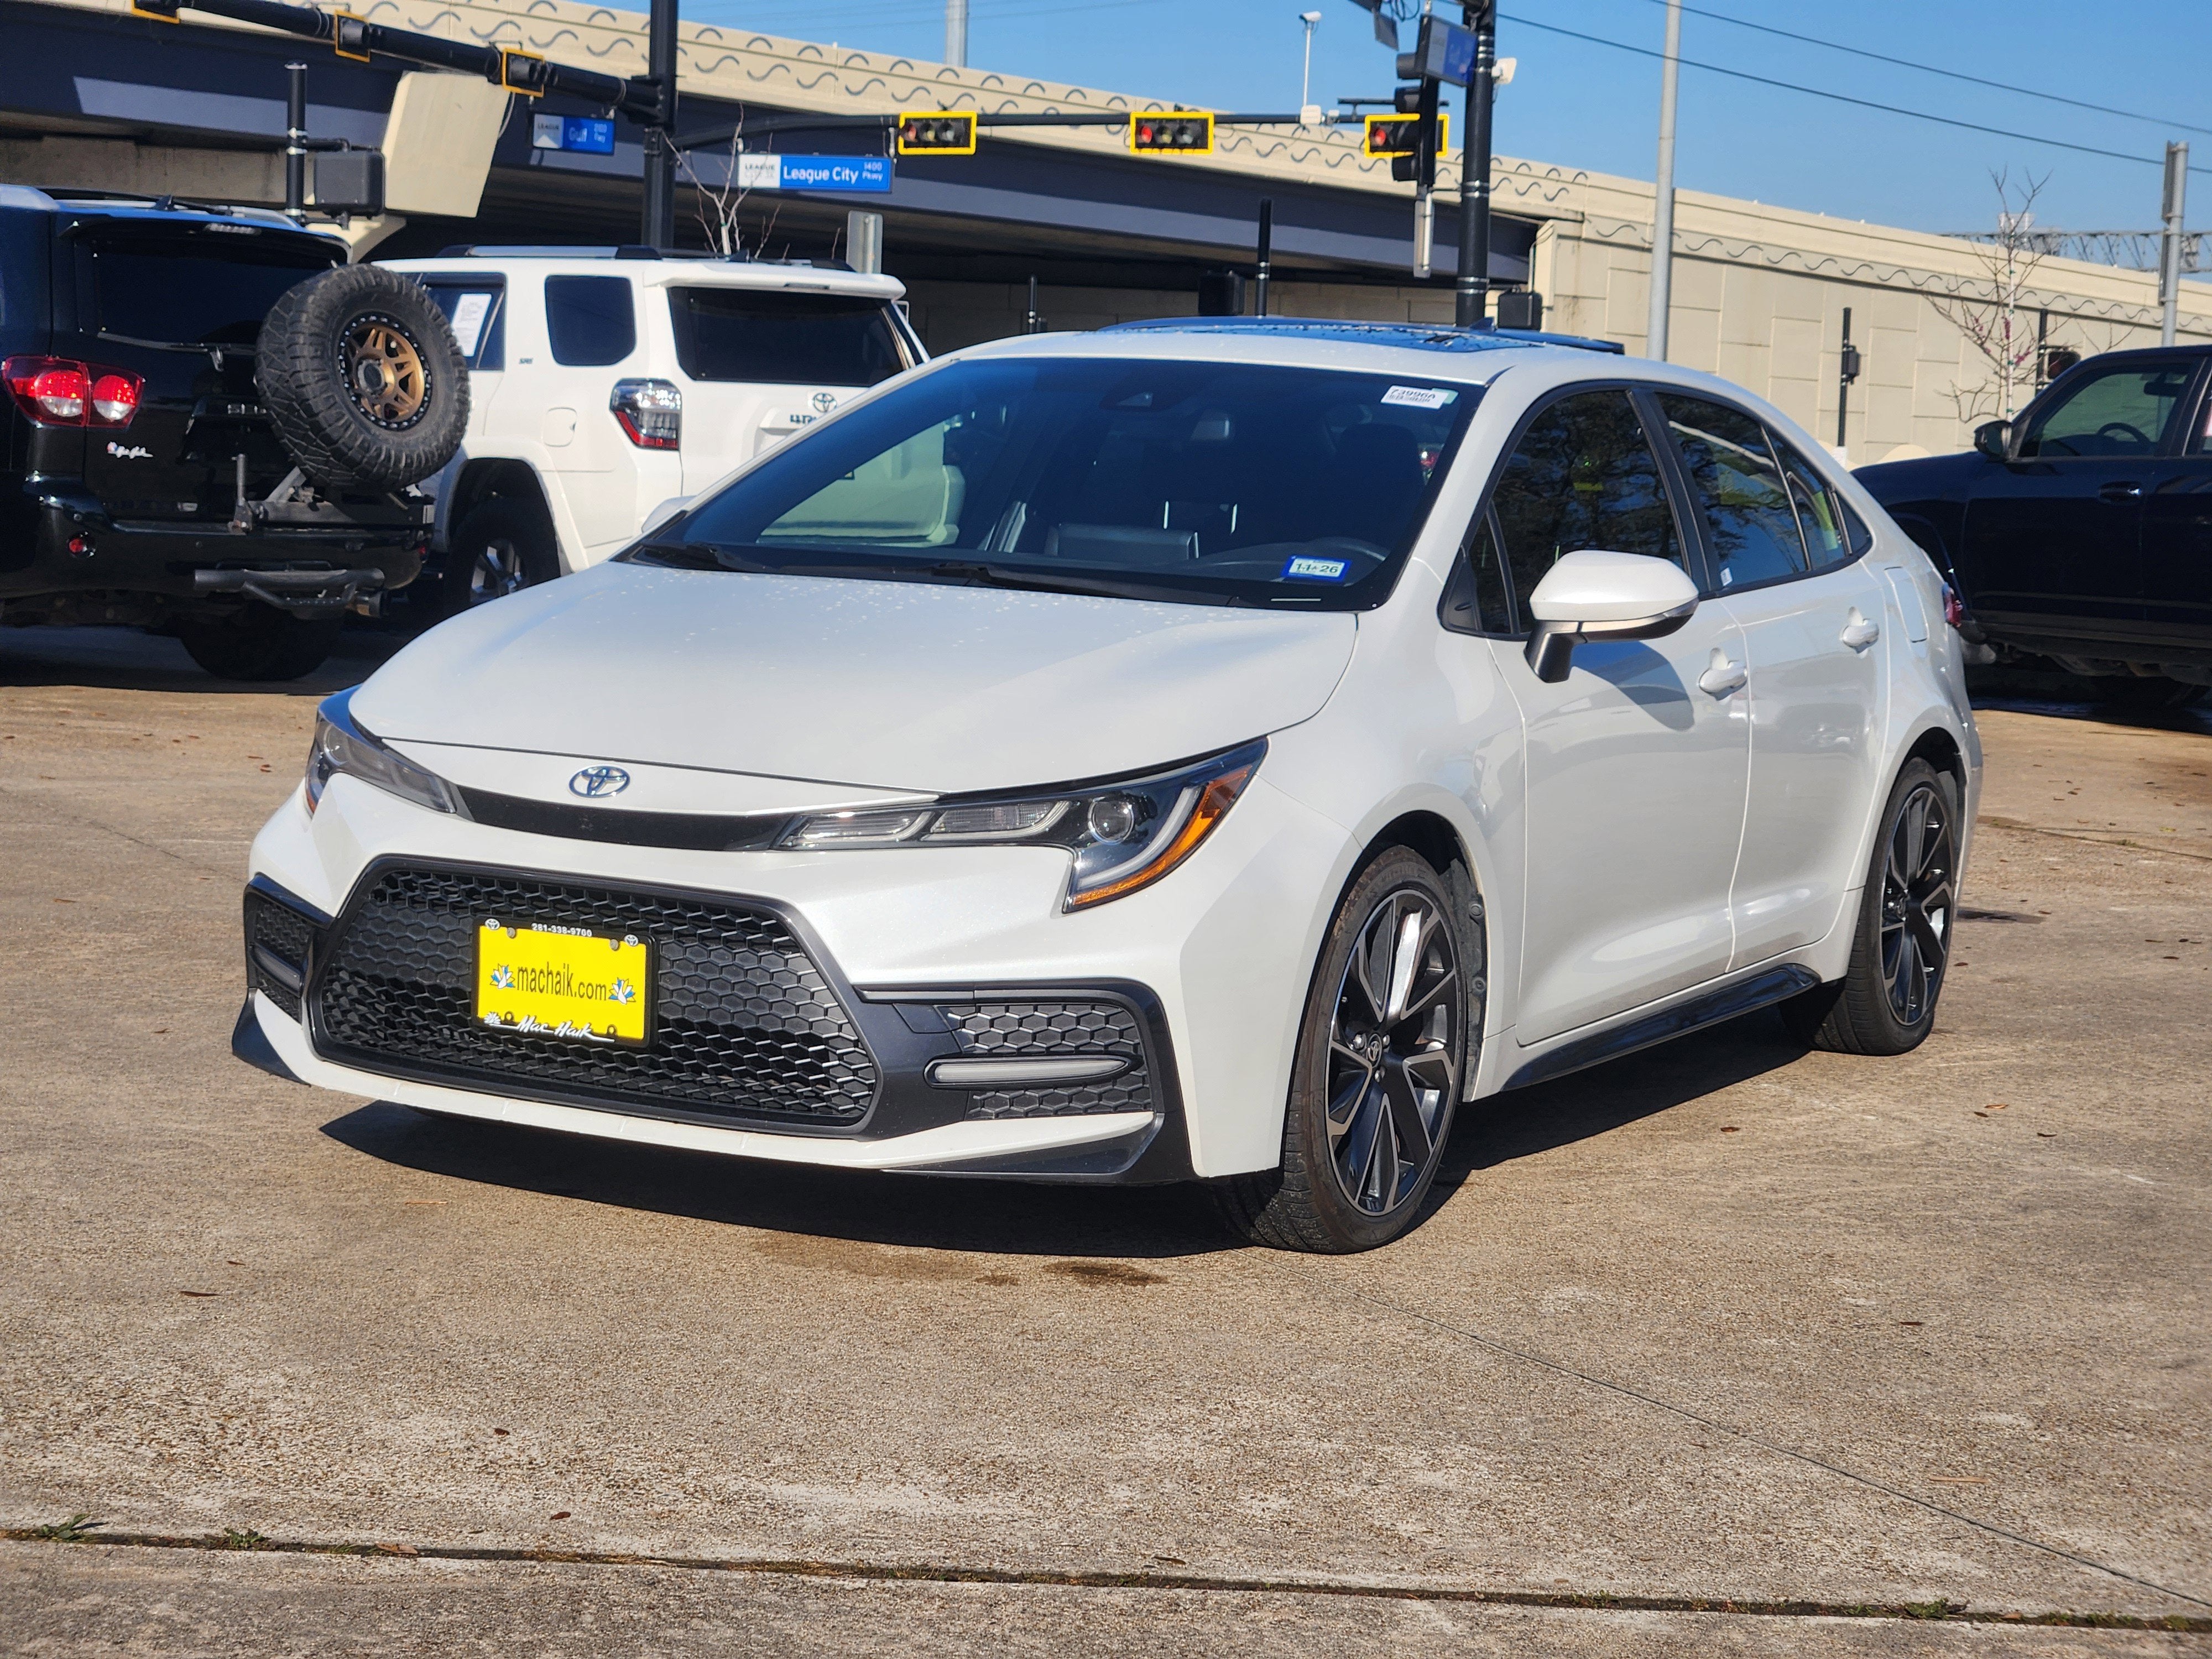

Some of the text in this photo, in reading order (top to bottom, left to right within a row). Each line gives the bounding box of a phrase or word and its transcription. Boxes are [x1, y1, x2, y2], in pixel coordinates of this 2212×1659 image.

[783, 165, 858, 184] League City
[531, 922, 592, 937] 281-338-9700
[517, 962, 607, 1001] machaik.com
[517, 1015, 597, 1039] Mac Haik
